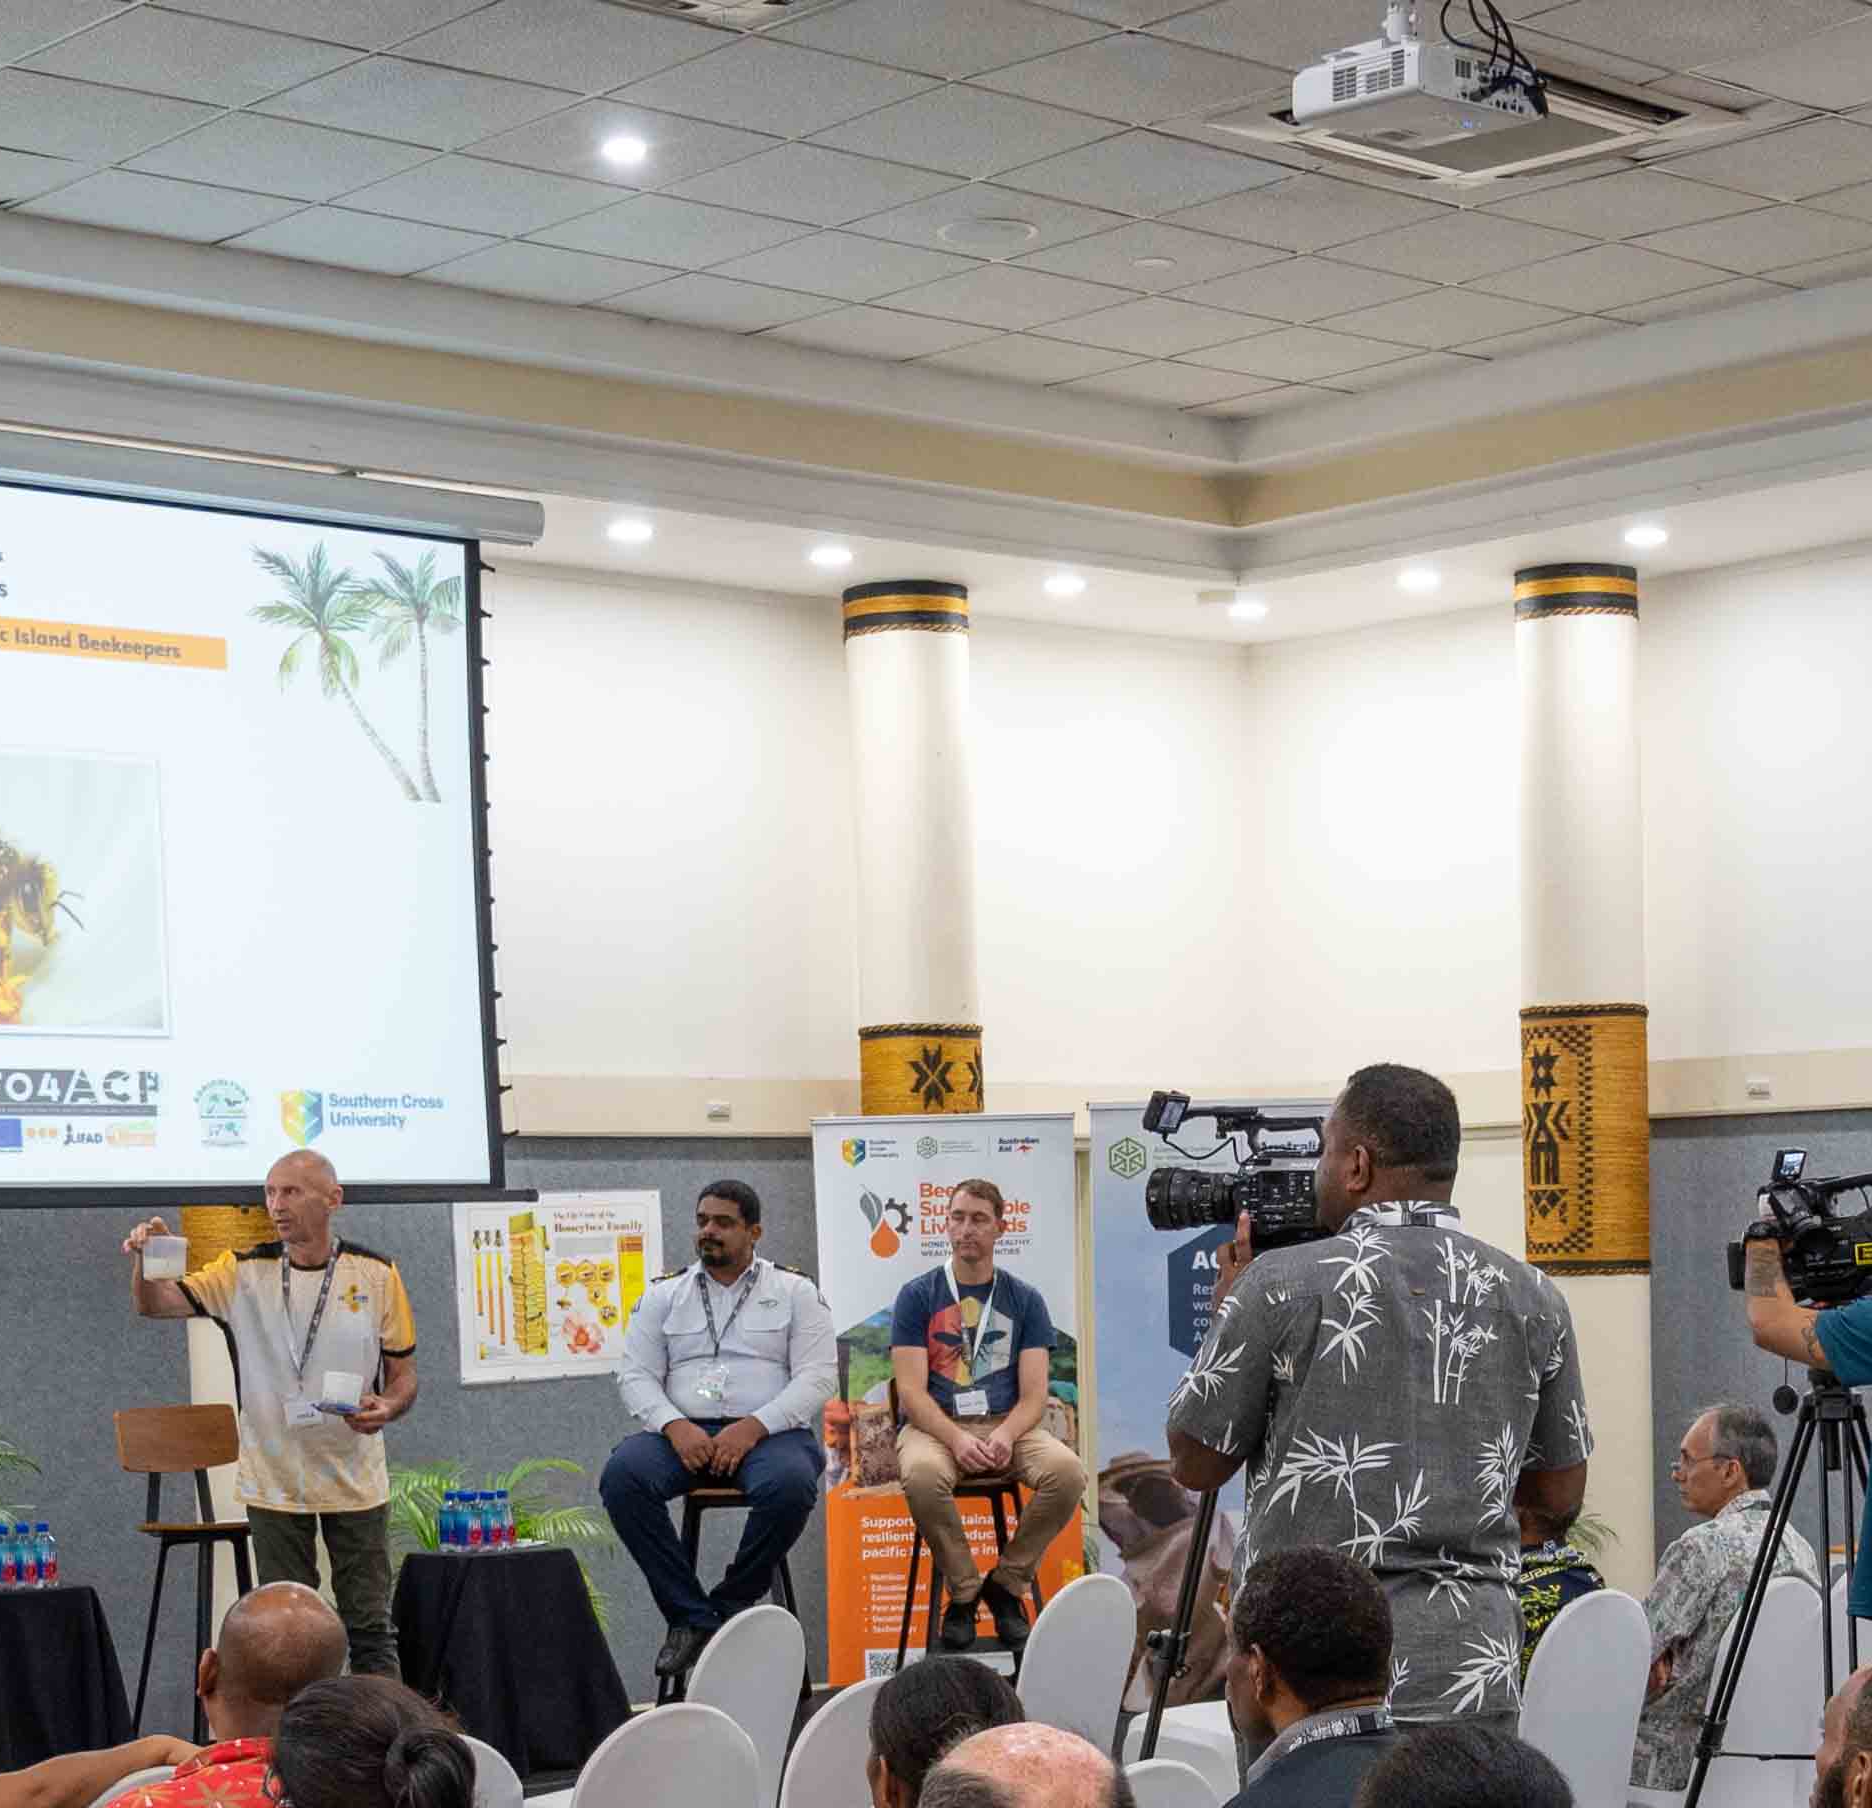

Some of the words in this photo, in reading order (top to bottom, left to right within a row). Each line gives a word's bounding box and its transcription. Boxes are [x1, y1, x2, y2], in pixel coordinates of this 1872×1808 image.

[14, 626, 72, 649] Island
[78, 632, 182, 661] Beekeepers
[328, 1093, 398, 1110] Southern
[401, 1095, 444, 1110] Cross
[330, 1112, 406, 1131] University
[860, 1516, 915, 1530] Support
[862, 1544, 908, 1561] pacific
